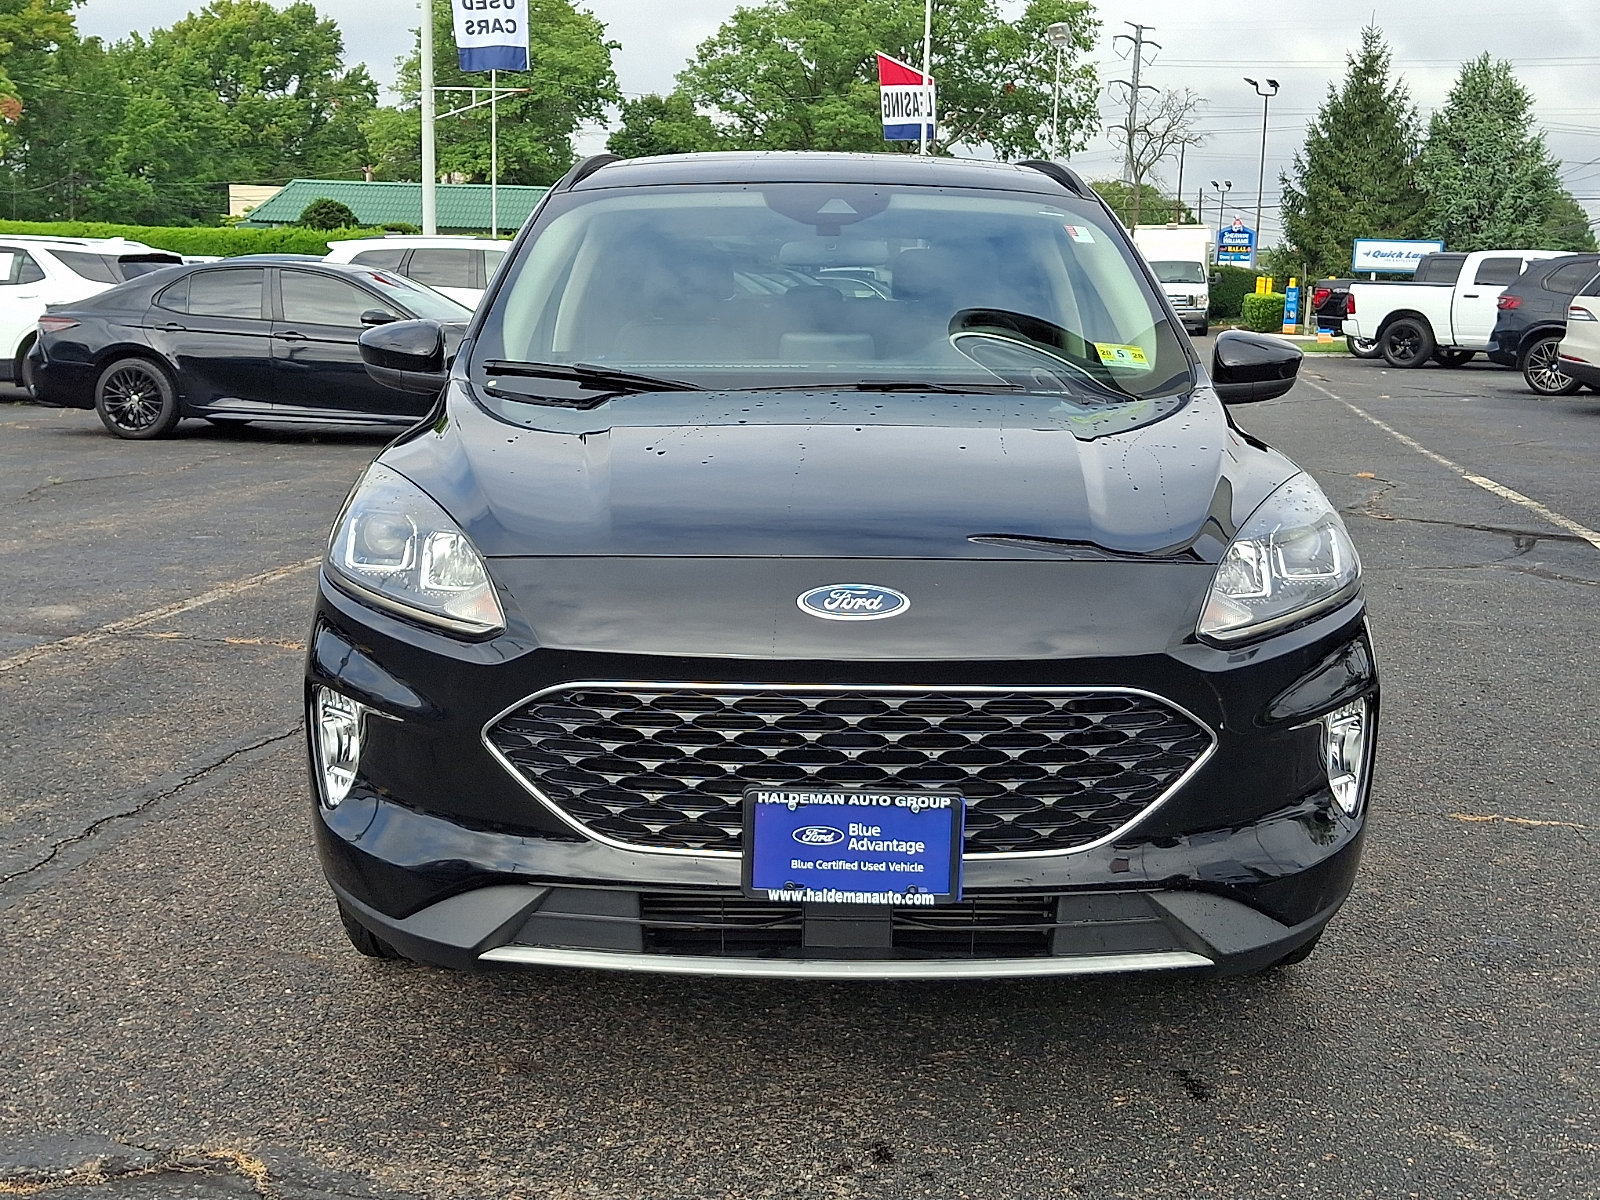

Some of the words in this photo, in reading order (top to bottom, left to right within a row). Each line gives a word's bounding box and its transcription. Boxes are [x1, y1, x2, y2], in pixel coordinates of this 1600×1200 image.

[1372, 250, 1405, 259] Quick
[1116, 349, 1125, 358] 5
[823, 589, 884, 610] Ford
[758, 792, 845, 806] HALDEMAN
[848, 795, 890, 807] AUTO
[895, 796, 951, 809] GROUP
[801, 828, 835, 843] Ford
[848, 823, 881, 837] Blue
[847, 837, 925, 855] Advantage
[791, 859, 814, 869] Blue
[815, 859, 857, 871] Certified
[860, 861, 886, 872] Used
[888, 861, 925, 873] Vehicle
[767, 888, 935, 905] www.haldemanauto.com
